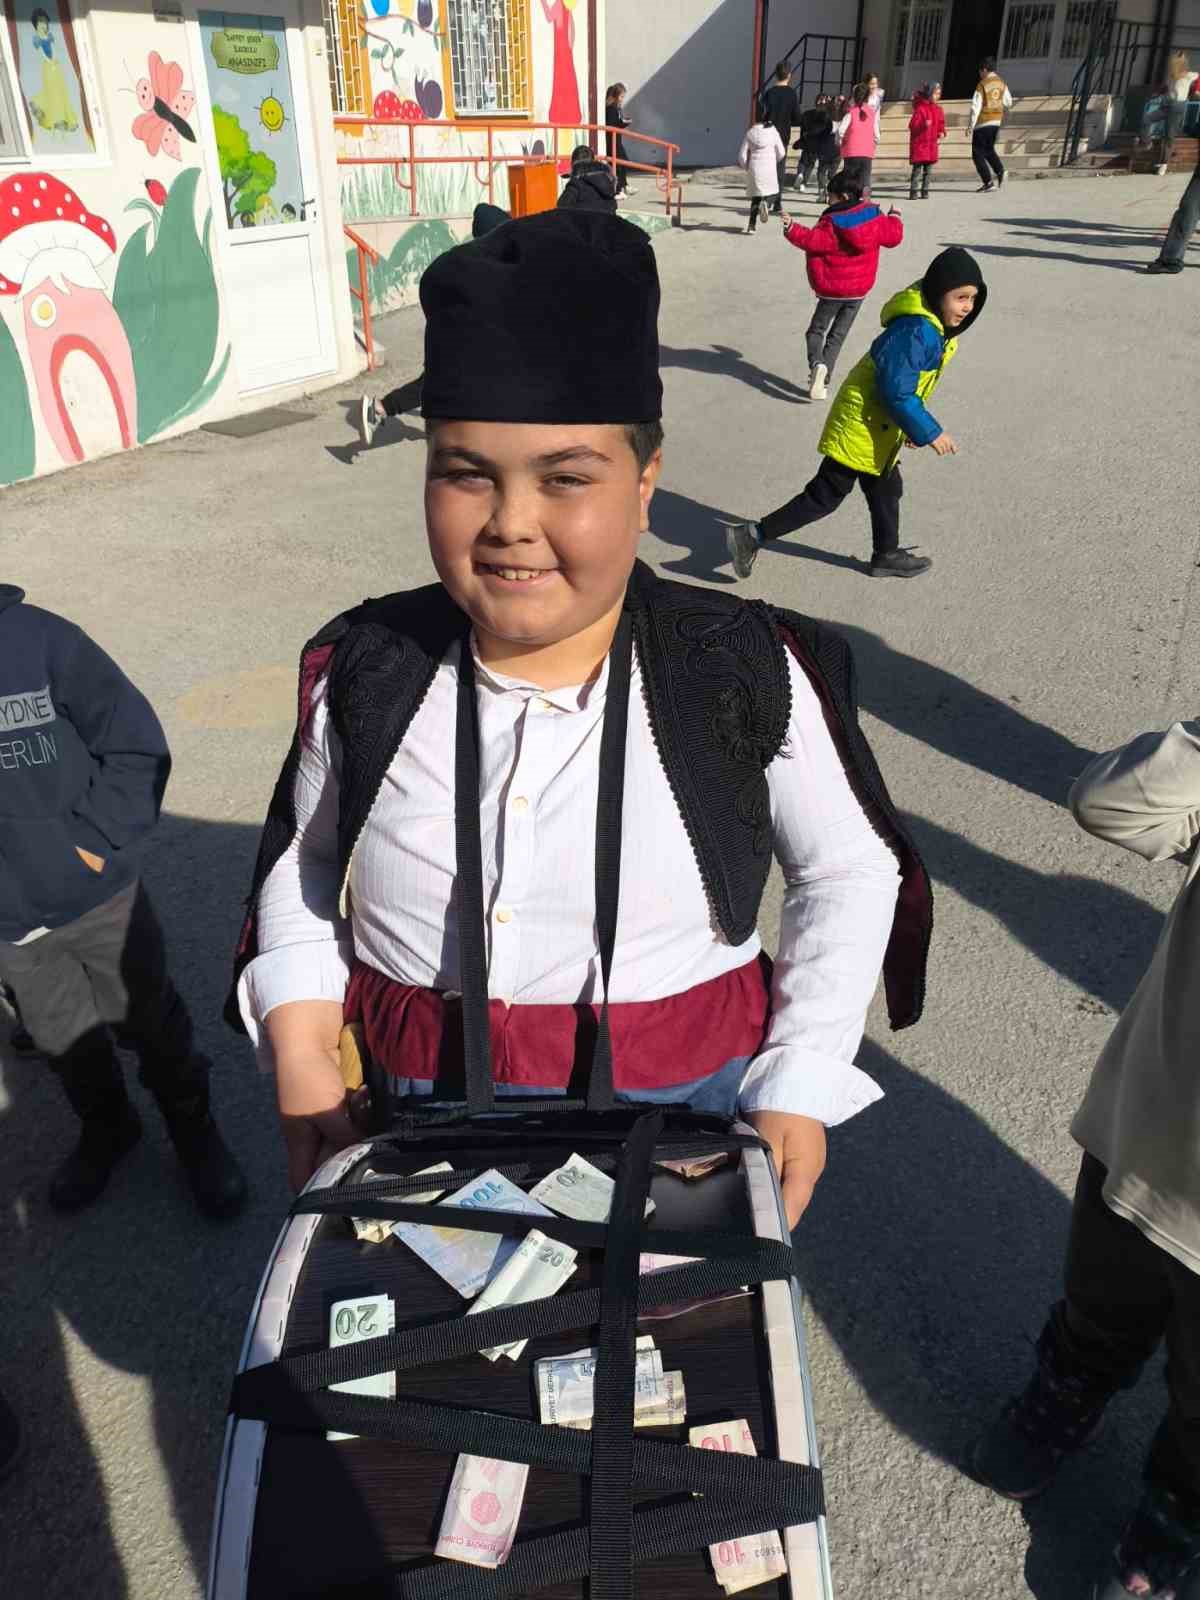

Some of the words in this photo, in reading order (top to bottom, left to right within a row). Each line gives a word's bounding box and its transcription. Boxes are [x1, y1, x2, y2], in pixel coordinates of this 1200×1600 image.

[539, 1247, 564, 1267] 20
[334, 1303, 379, 1340] 20
[718, 1541, 745, 1567] 10
